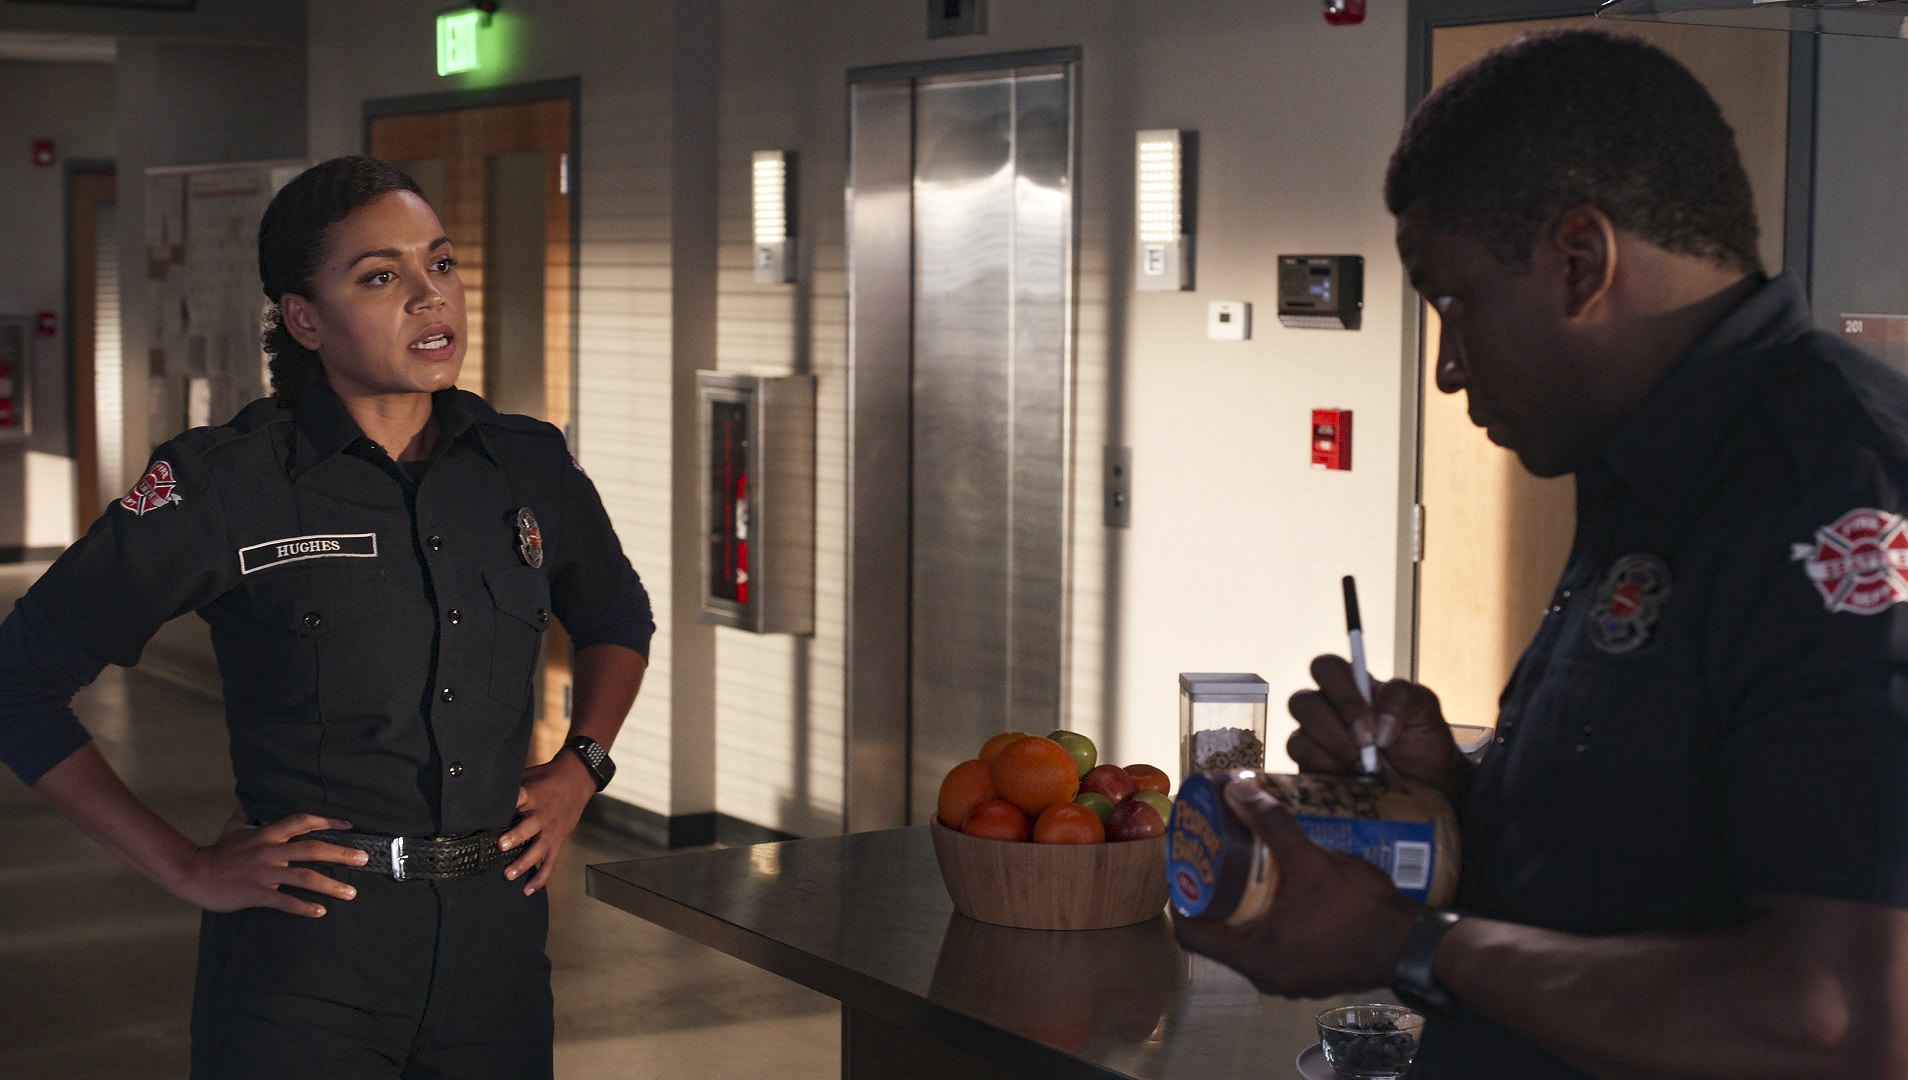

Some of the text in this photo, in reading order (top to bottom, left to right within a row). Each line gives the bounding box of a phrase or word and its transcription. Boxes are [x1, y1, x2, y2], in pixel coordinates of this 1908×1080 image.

[1845, 320, 1863, 333] 201
[156, 464, 169, 480] FIRE
[276, 540, 341, 558] HUGHES
[1174, 800, 1221, 862] Peanut
[1172, 830, 1215, 885] Butter
